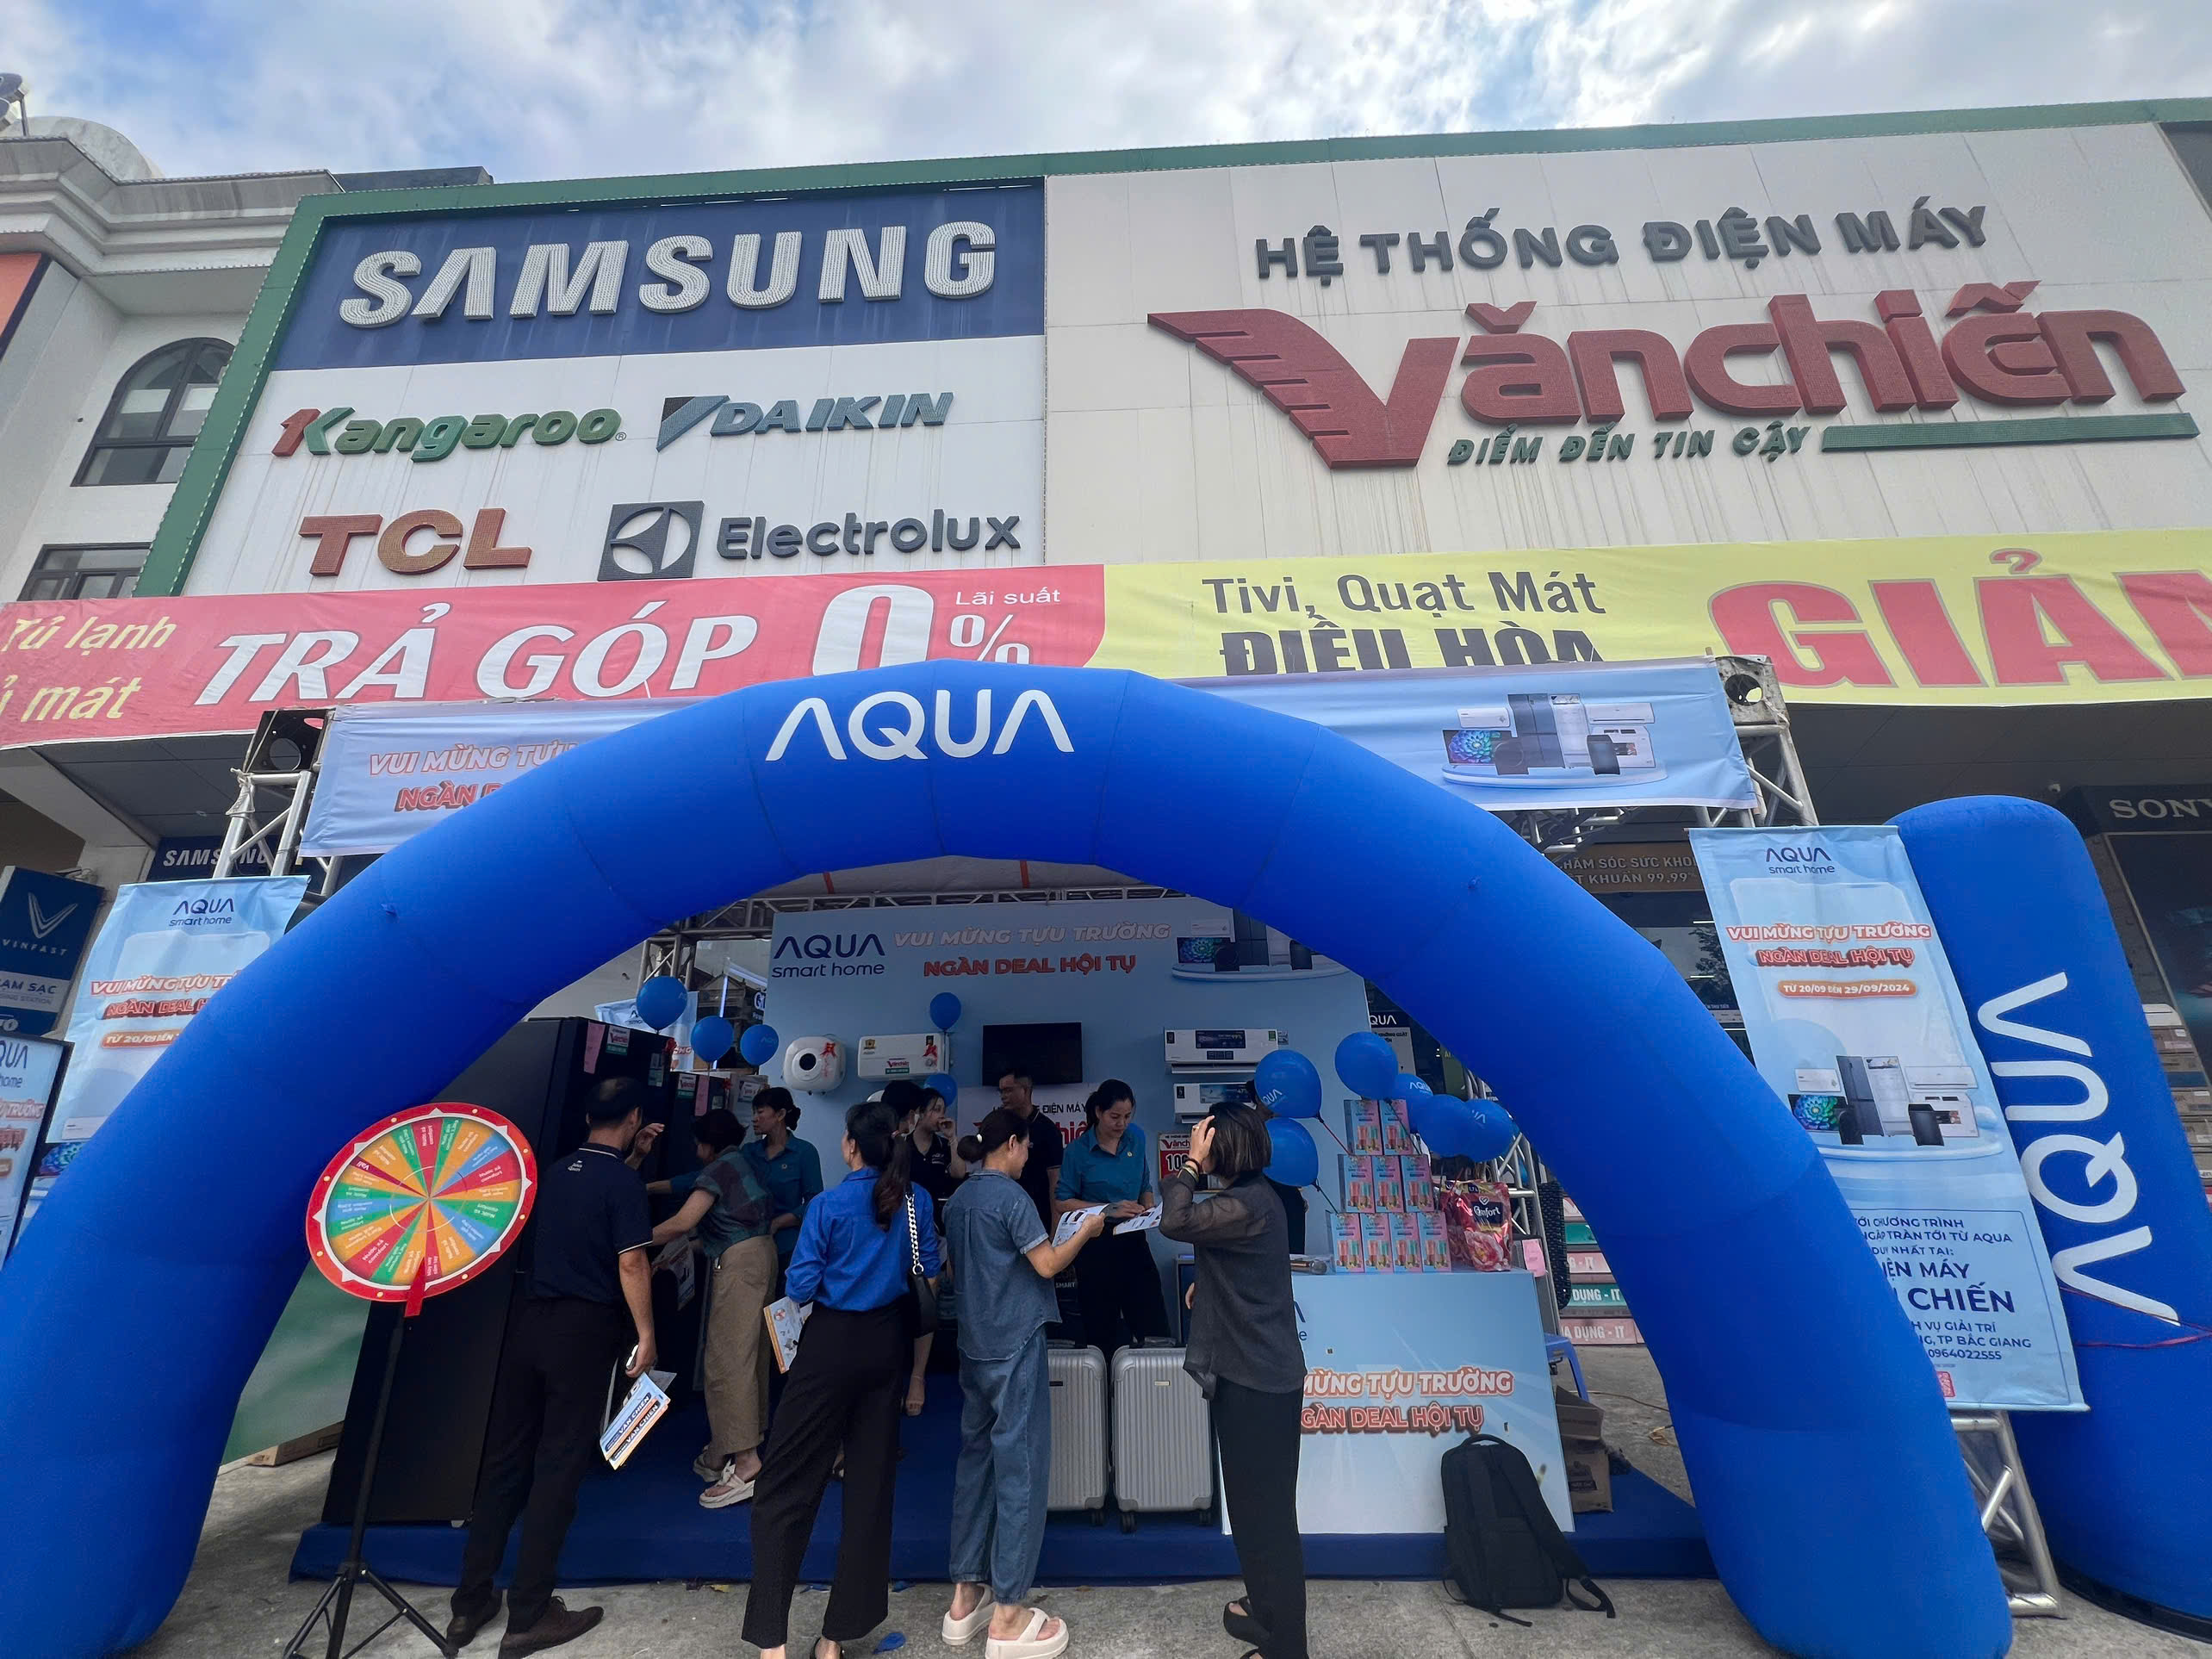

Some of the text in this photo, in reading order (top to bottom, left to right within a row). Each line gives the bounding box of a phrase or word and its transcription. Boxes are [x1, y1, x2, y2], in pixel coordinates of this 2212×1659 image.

[1255, 196, 1989, 285] HỆ THỐNG ĐIỆN MÁY
[339, 220, 997, 329] SAMSUNG
[710, 392, 954, 437] DAIKIN
[1447, 419, 1811, 465] ĐIỂM ĐẾN TIN CẬY
[298, 507, 532, 576] TCL
[716, 508, 1022, 560] Electrolux
[955, 587, 1061, 606] Lãi suất
[1202, 570, 1606, 618] Tivi, Quạt Mát
[64, 616, 177, 656] lạnh
[194, 602, 452, 706] TRẢ
[475, 601, 759, 699] GÓP
[21, 676, 142, 723] mát
[766, 688, 1075, 761] AQUA
[370, 751, 420, 776] VUI
[421, 743, 510, 773] MỪNG
[395, 780, 477, 812] NGÀN
[1599, 855, 1626, 869] SÓC
[1766, 847, 1832, 862] AQUA
[1768, 864, 1835, 874] smart home
[172, 898, 234, 915] AQUA
[169, 915, 233, 928] smart home
[894, 922, 1171, 948] VUI MỪNG TỰU TRƯỜNG
[1727, 922, 1931, 943] VUI MỪNG TỰU TRƯỜNG
[3, 939, 68, 956] VINFAST
[773, 934, 885, 960] AQUA
[1755, 946, 1914, 968] NGÀN DEAL HỘI TỤ
[772, 963, 885, 979] smart home
[923, 952, 1137, 978] NGÀN DEAL HỘI TỤ
[28, 983, 58, 995] SẠC
[91, 980, 122, 995] VUI
[123, 975, 177, 992] MỪNG
[1799, 984, 1826, 993] 20/09
[1844, 984, 1910, 994] 29/09/2024
[1370, 1015, 1397, 1025] QUA
[1042, 1102, 1064, 1115] ĐIỆN
[1978, 972, 2181, 1327] AQUA
[1923, 1216, 1965, 1228] TRÌNH
[1886, 1230, 1922, 1240] TRÀN
[1924, 1230, 1946, 1240] TỚI
[1949, 1230, 1968, 1241] TỪ
[1973, 1233, 2012, 1244] AQUA
[1892, 1246, 1924, 1255] NHẤT
[1929, 1246, 1954, 1257] TẠI:
[1919, 1258, 1970, 1279] MÁY
[1572, 1289, 1602, 1303] DỤNG
[1907, 1282, 2016, 1313] CHIẾN
[1574, 1326, 1605, 1341] DỤNG
[1614, 1326, 1625, 1339] IT
[1924, 1322, 1941, 1332] VỤ
[1975, 1322, 1996, 1333] TRÍ
[1939, 1336, 1953, 1345] TP
[1989, 1338, 2032, 1348] GIANG
[1929, 1349, 2002, 1360] 0964022555
[1367, 1367, 1414, 1400] TỰU
[1419, 1366, 1514, 1396] TRƯỜNG
[1301, 1401, 1484, 1435] GÀN DEAL HỘI TỤ
